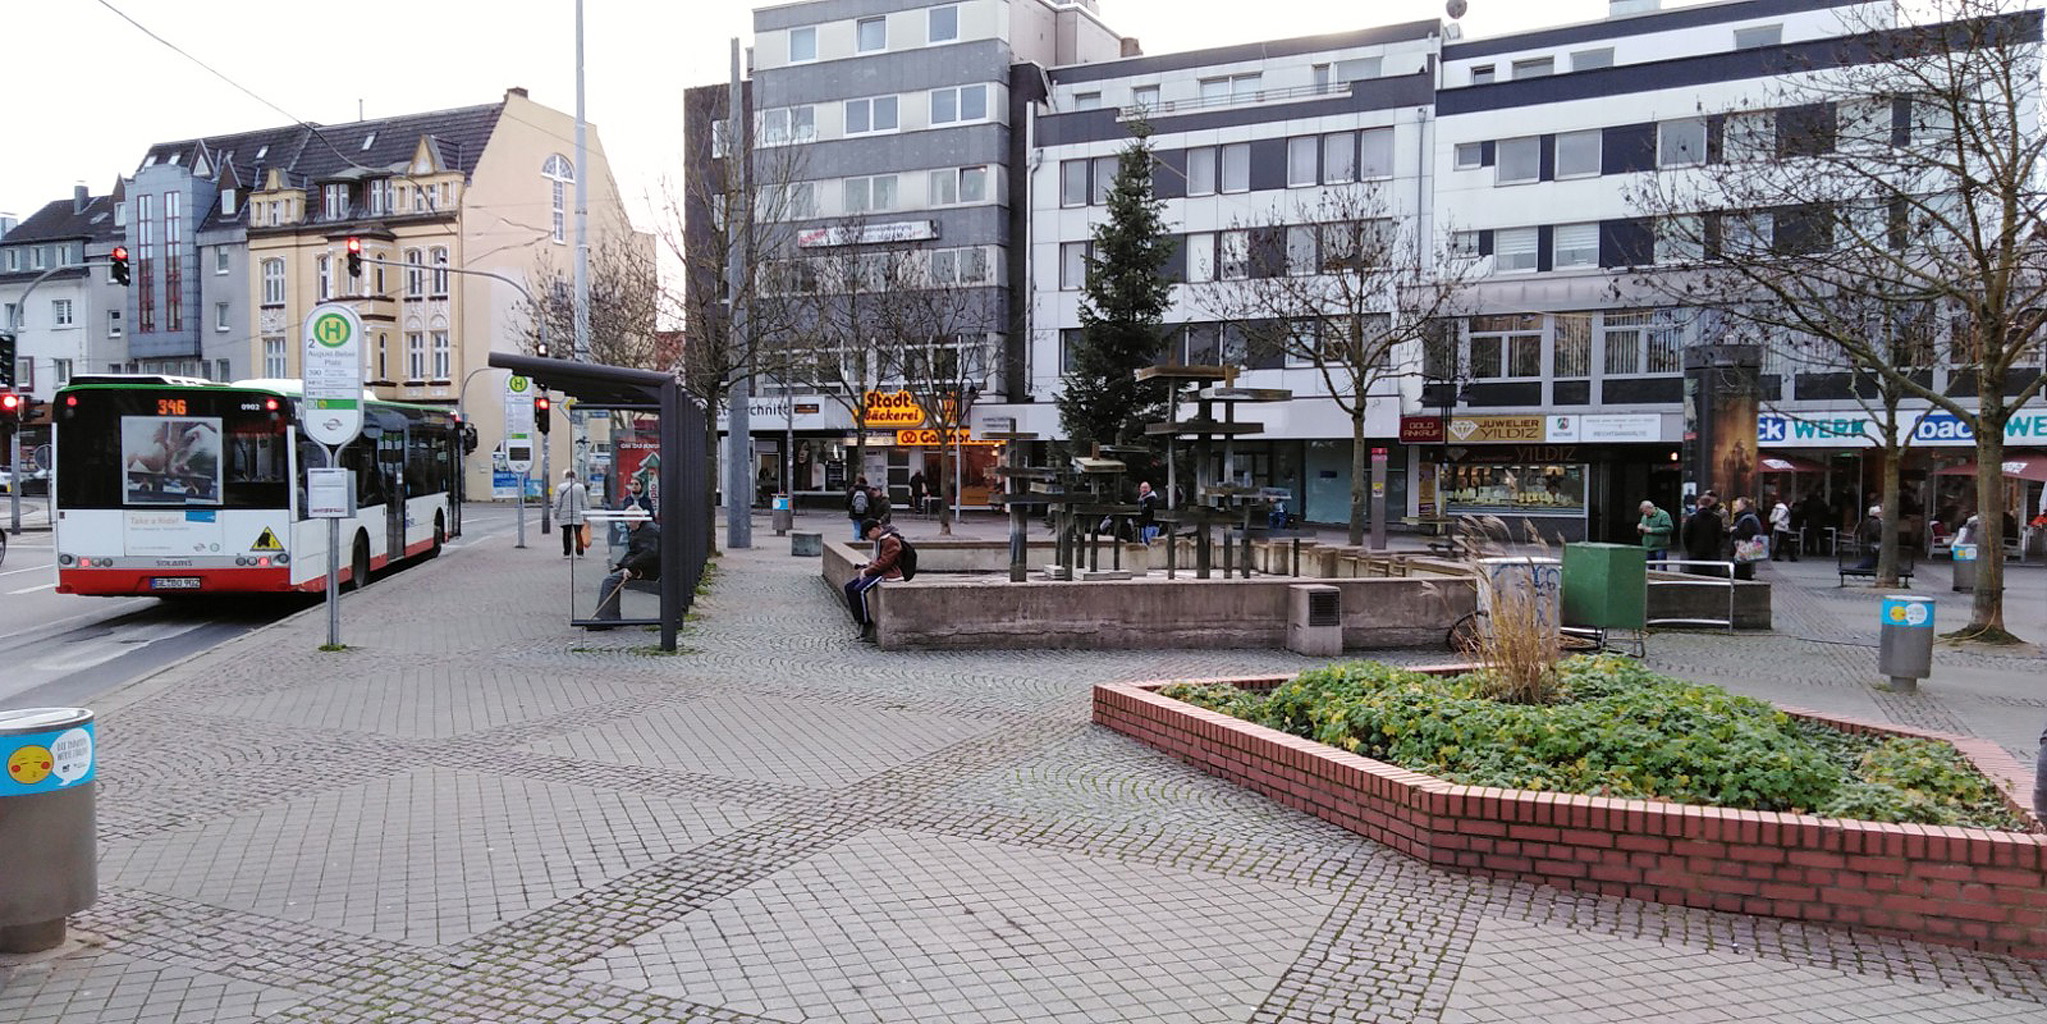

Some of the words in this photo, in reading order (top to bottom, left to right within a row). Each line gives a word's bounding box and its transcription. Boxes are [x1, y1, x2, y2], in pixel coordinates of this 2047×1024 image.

[308, 339, 316, 349] 2
[866, 391, 910, 408] Stadt
[158, 399, 186, 415] 346
[241, 403, 260, 411] 0902
[864, 409, 919, 421] Bäckerei
[1409, 422, 1430, 430] GOLD
[1479, 419, 1539, 428] JUWELIER
[1794, 418, 1866, 438] WERK
[1918, 417, 1973, 439] bac
[2005, 416, 2047, 437] WE
[1403, 429, 1440, 438] ANKAUF
[1480, 428, 1538, 438] YILDIZ
[1515, 445, 1577, 463] YILDIZ
